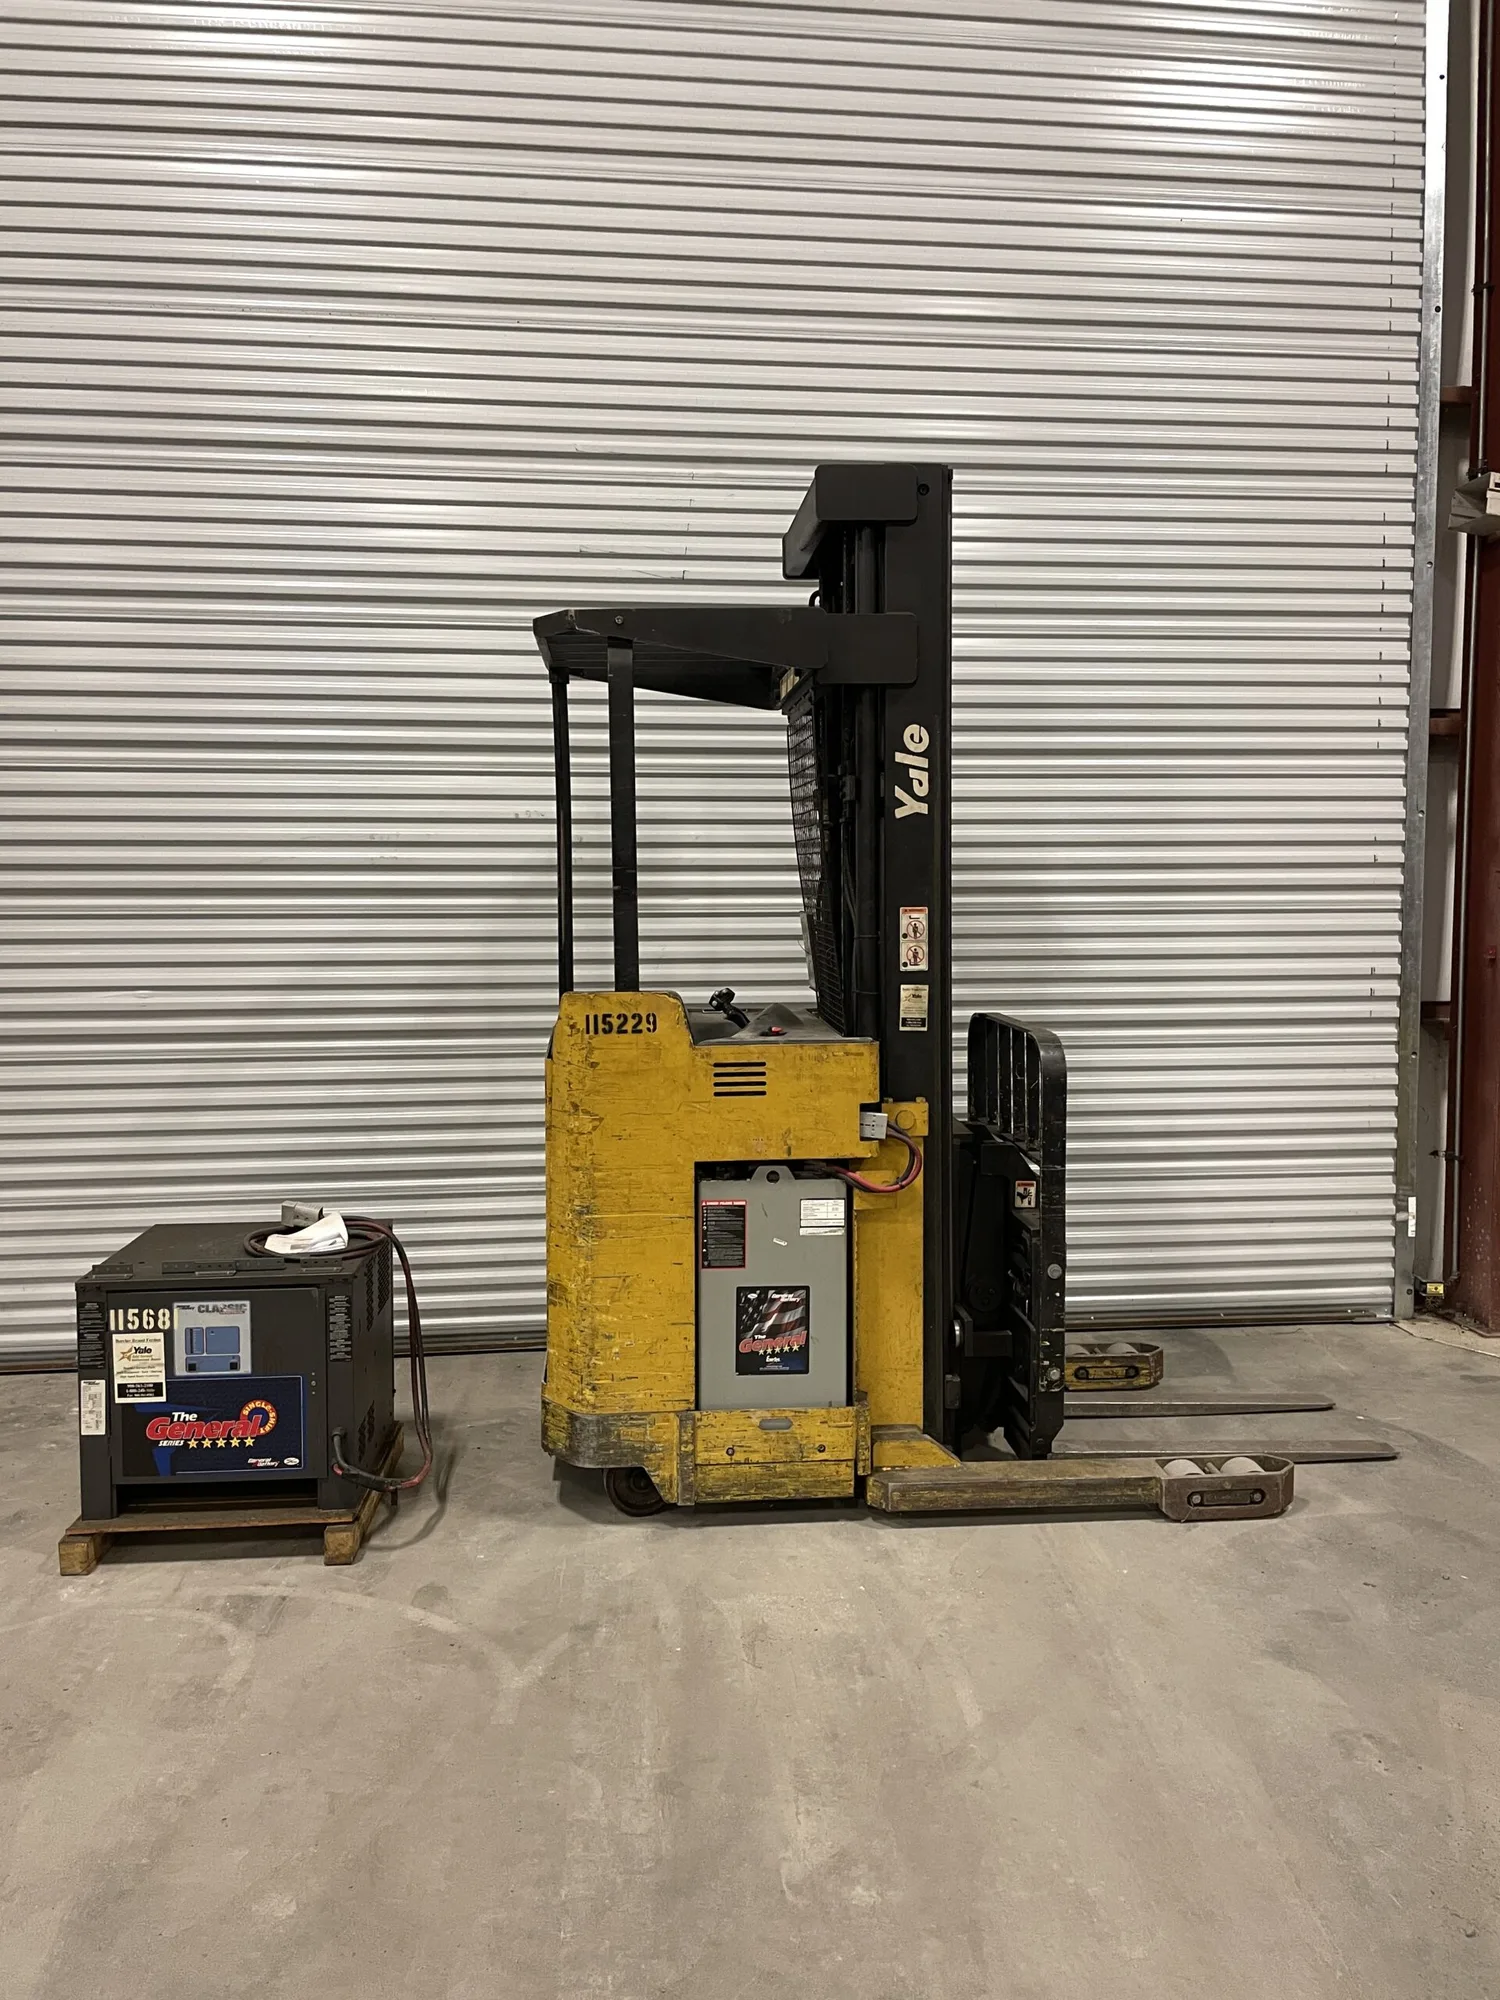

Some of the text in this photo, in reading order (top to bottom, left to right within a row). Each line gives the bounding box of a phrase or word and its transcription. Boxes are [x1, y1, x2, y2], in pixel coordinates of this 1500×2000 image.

[895, 724, 929, 819] Yale
[585, 1013, 658, 1035] 115229
[198, 1304, 248, 1314] CLASSIC
[738, 1331, 808, 1354] General
[145, 1414, 263, 1440] General
[171, 1411, 198, 1422] The
